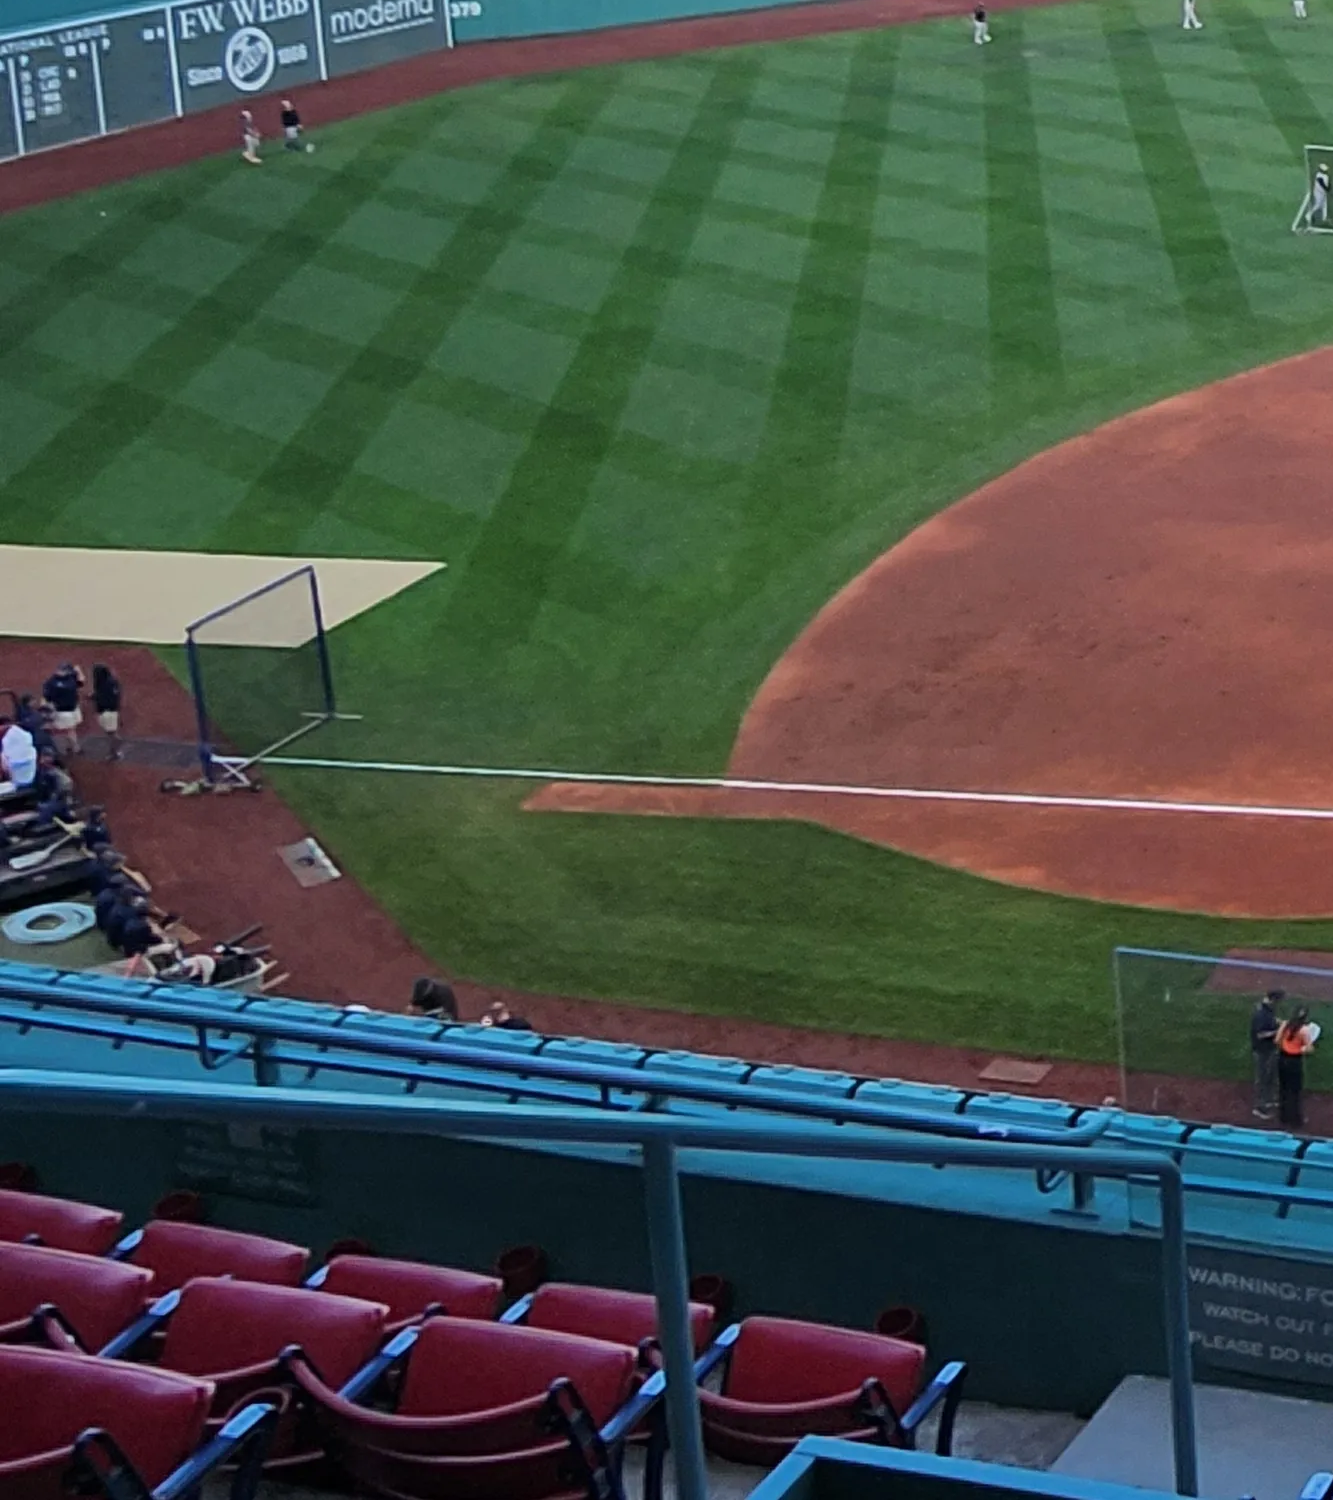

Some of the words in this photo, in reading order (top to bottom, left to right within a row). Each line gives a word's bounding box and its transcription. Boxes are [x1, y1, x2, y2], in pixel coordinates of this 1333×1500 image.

[450, 1, 482, 19] 379
[1187, 1265, 1303, 1301] WARNING:
[1202, 1301, 1269, 1327] WATCH
[1275, 1315, 1314, 1335] OUT
[1188, 1330, 1265, 1360] PLEASE
[1269, 1345, 1299, 1364] DO
